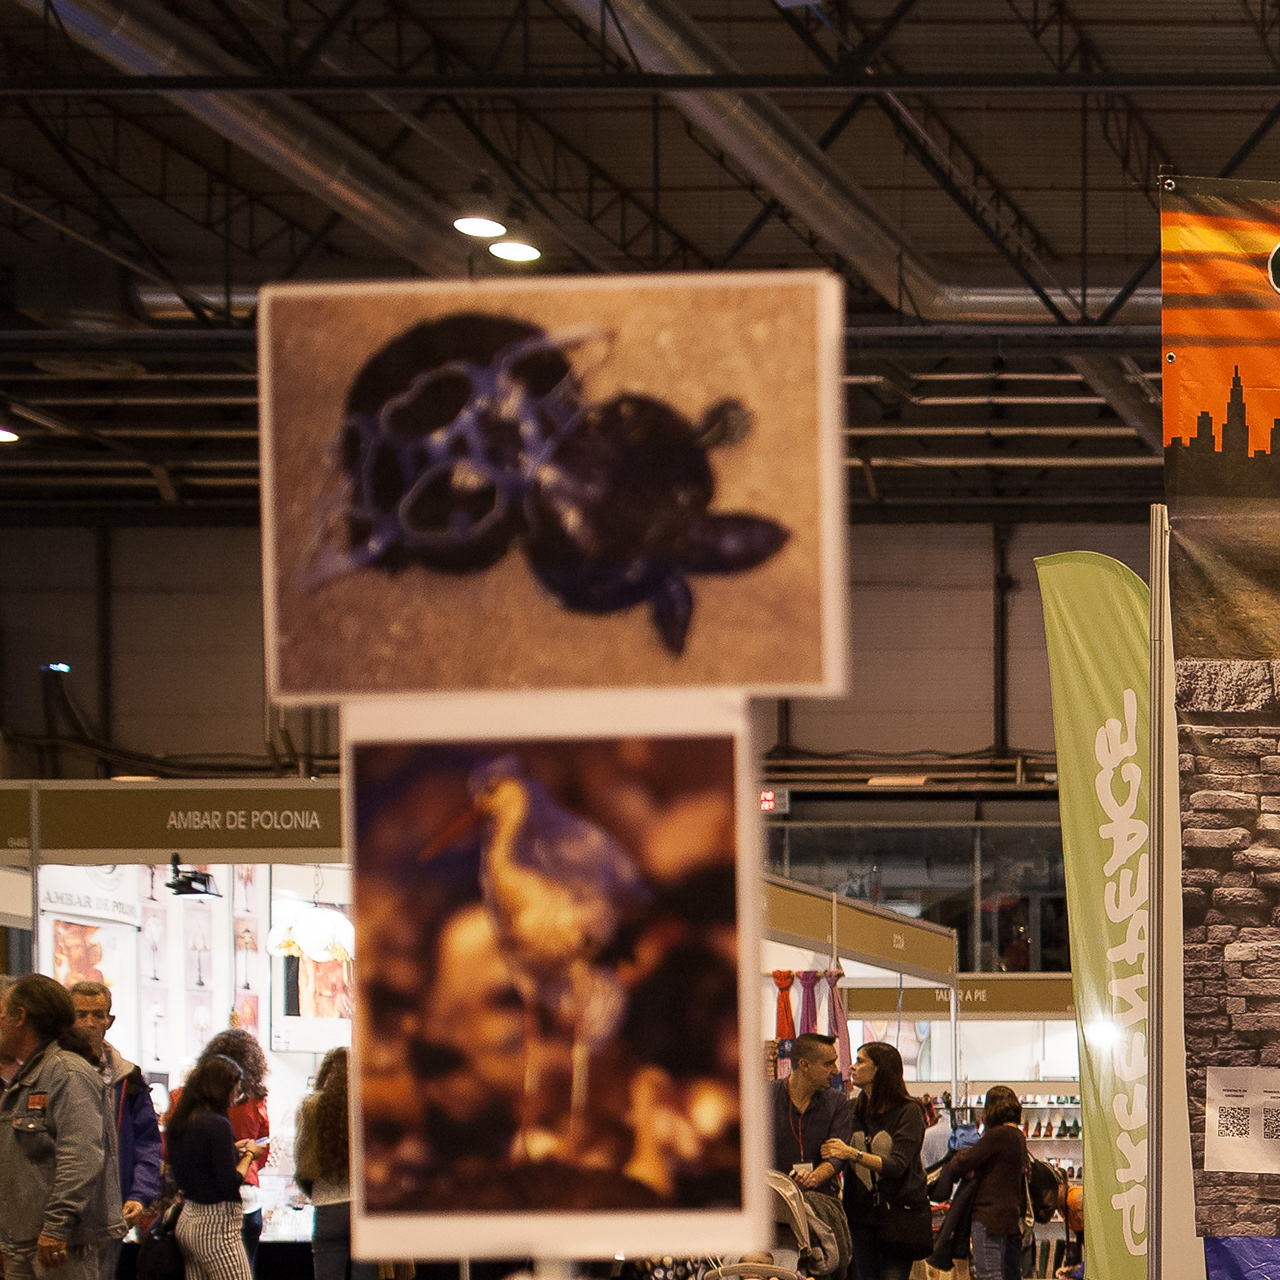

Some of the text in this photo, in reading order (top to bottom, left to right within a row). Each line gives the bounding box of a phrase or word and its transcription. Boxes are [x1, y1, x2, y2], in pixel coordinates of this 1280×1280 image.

[166, 810, 321, 830] AMBAR DE POLONIA
[43, 888, 92, 909] AMBAR
[935, 989, 988, 1002] TALLR A PIE
